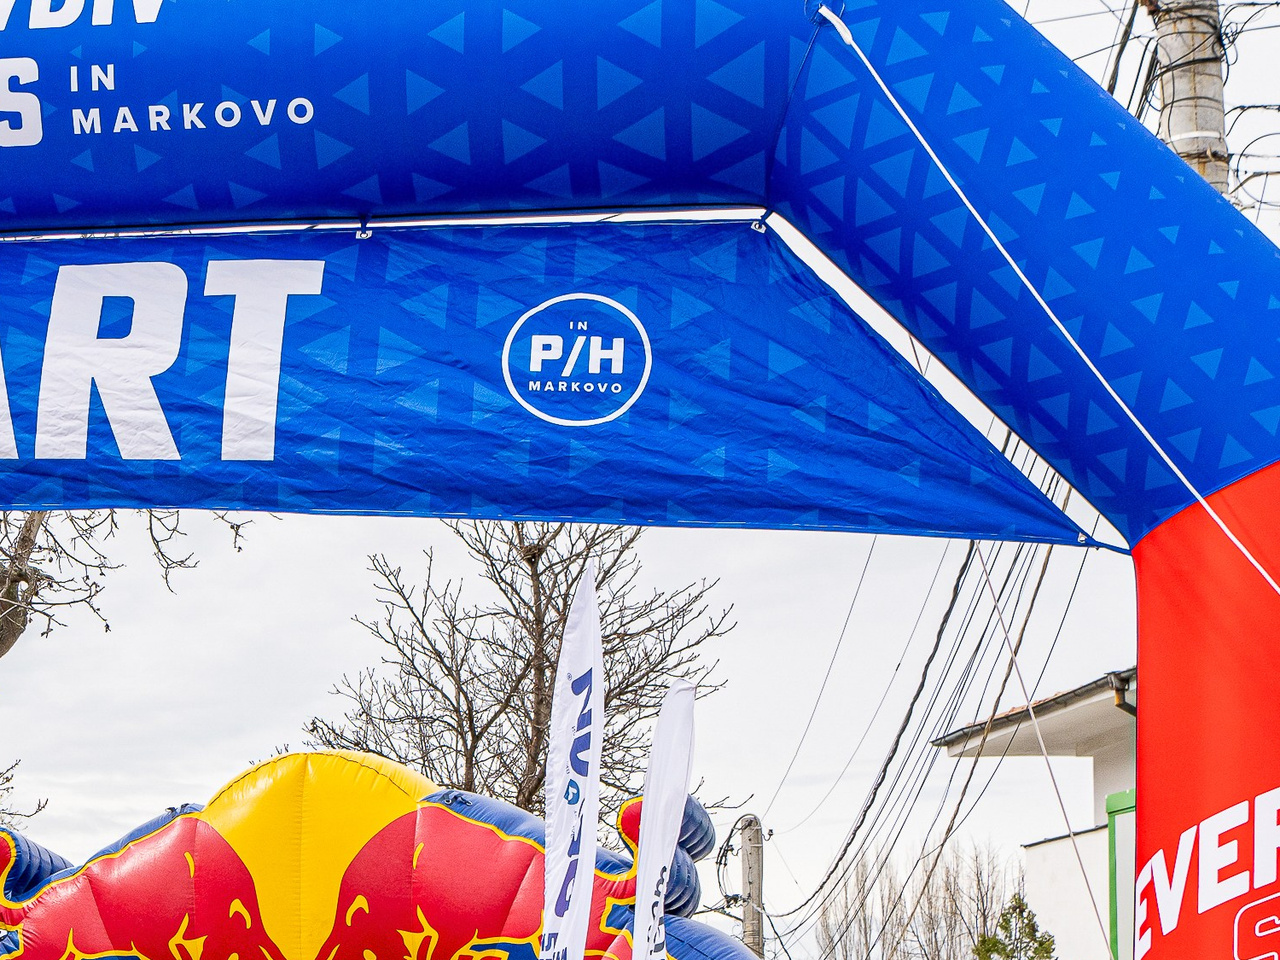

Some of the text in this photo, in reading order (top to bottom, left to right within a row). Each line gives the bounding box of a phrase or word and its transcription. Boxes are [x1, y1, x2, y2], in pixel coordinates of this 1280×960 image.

[70, 63, 115, 93] IN
[72, 97, 315, 135] MARKOVO
[569, 321, 588, 331] IN
[529, 335, 625, 378] P/H
[528, 381, 622, 394] MARKOVO
